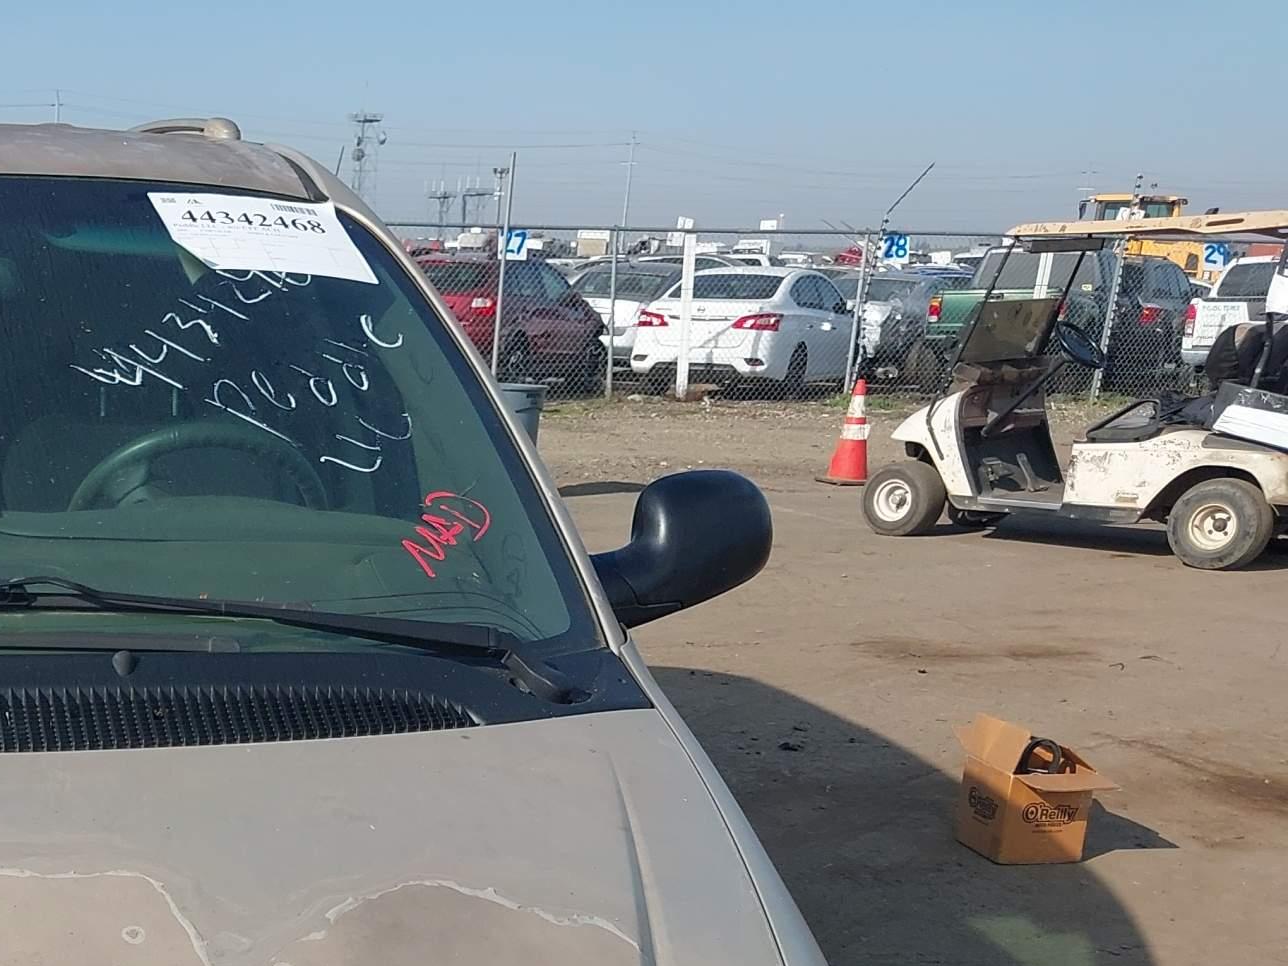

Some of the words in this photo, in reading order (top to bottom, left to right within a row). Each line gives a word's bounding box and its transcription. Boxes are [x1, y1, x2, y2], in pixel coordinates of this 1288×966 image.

[181, 209, 327, 234] 44342468
[500, 229, 527, 255] 27
[884, 233, 908, 258] 28
[1204, 243, 1230, 267] 29
[1023, 803, 1079, 824] O'Reilly
